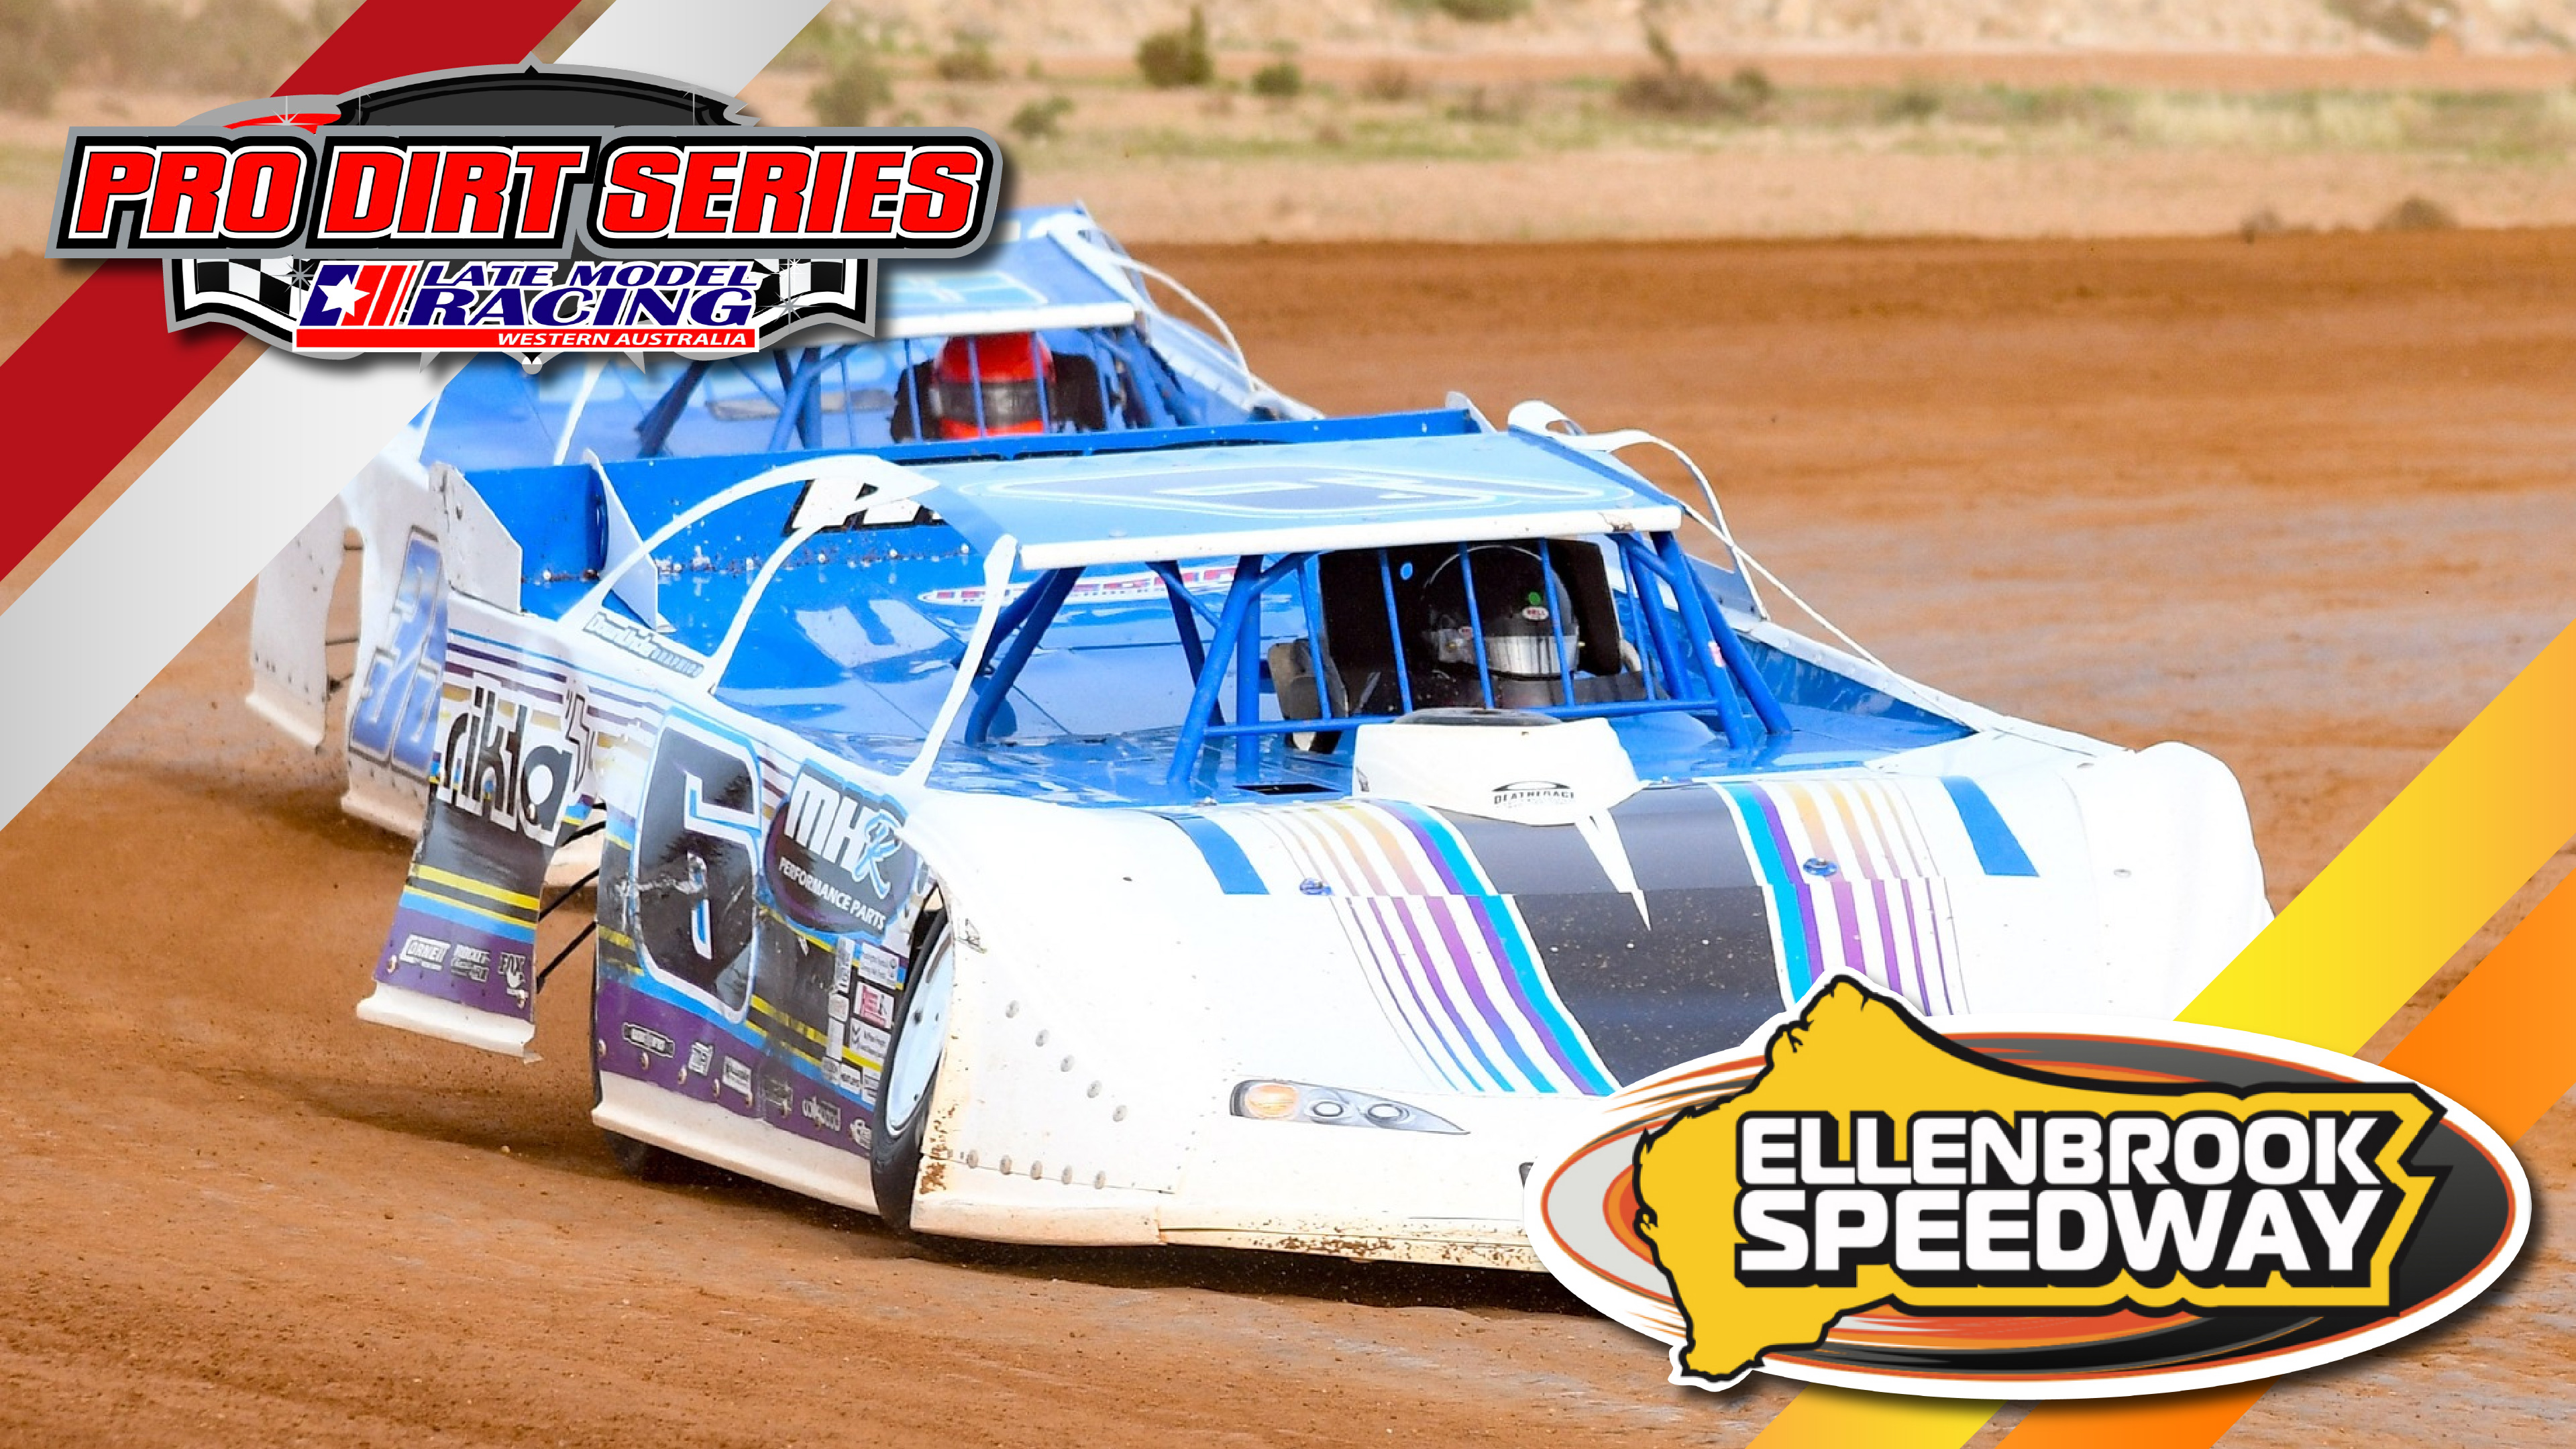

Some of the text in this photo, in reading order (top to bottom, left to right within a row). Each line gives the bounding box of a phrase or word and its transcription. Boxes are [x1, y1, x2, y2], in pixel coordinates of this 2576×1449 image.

[634, 716, 761, 1022] 6
[779, 857, 887, 930] PERFORMANCE PARTS
